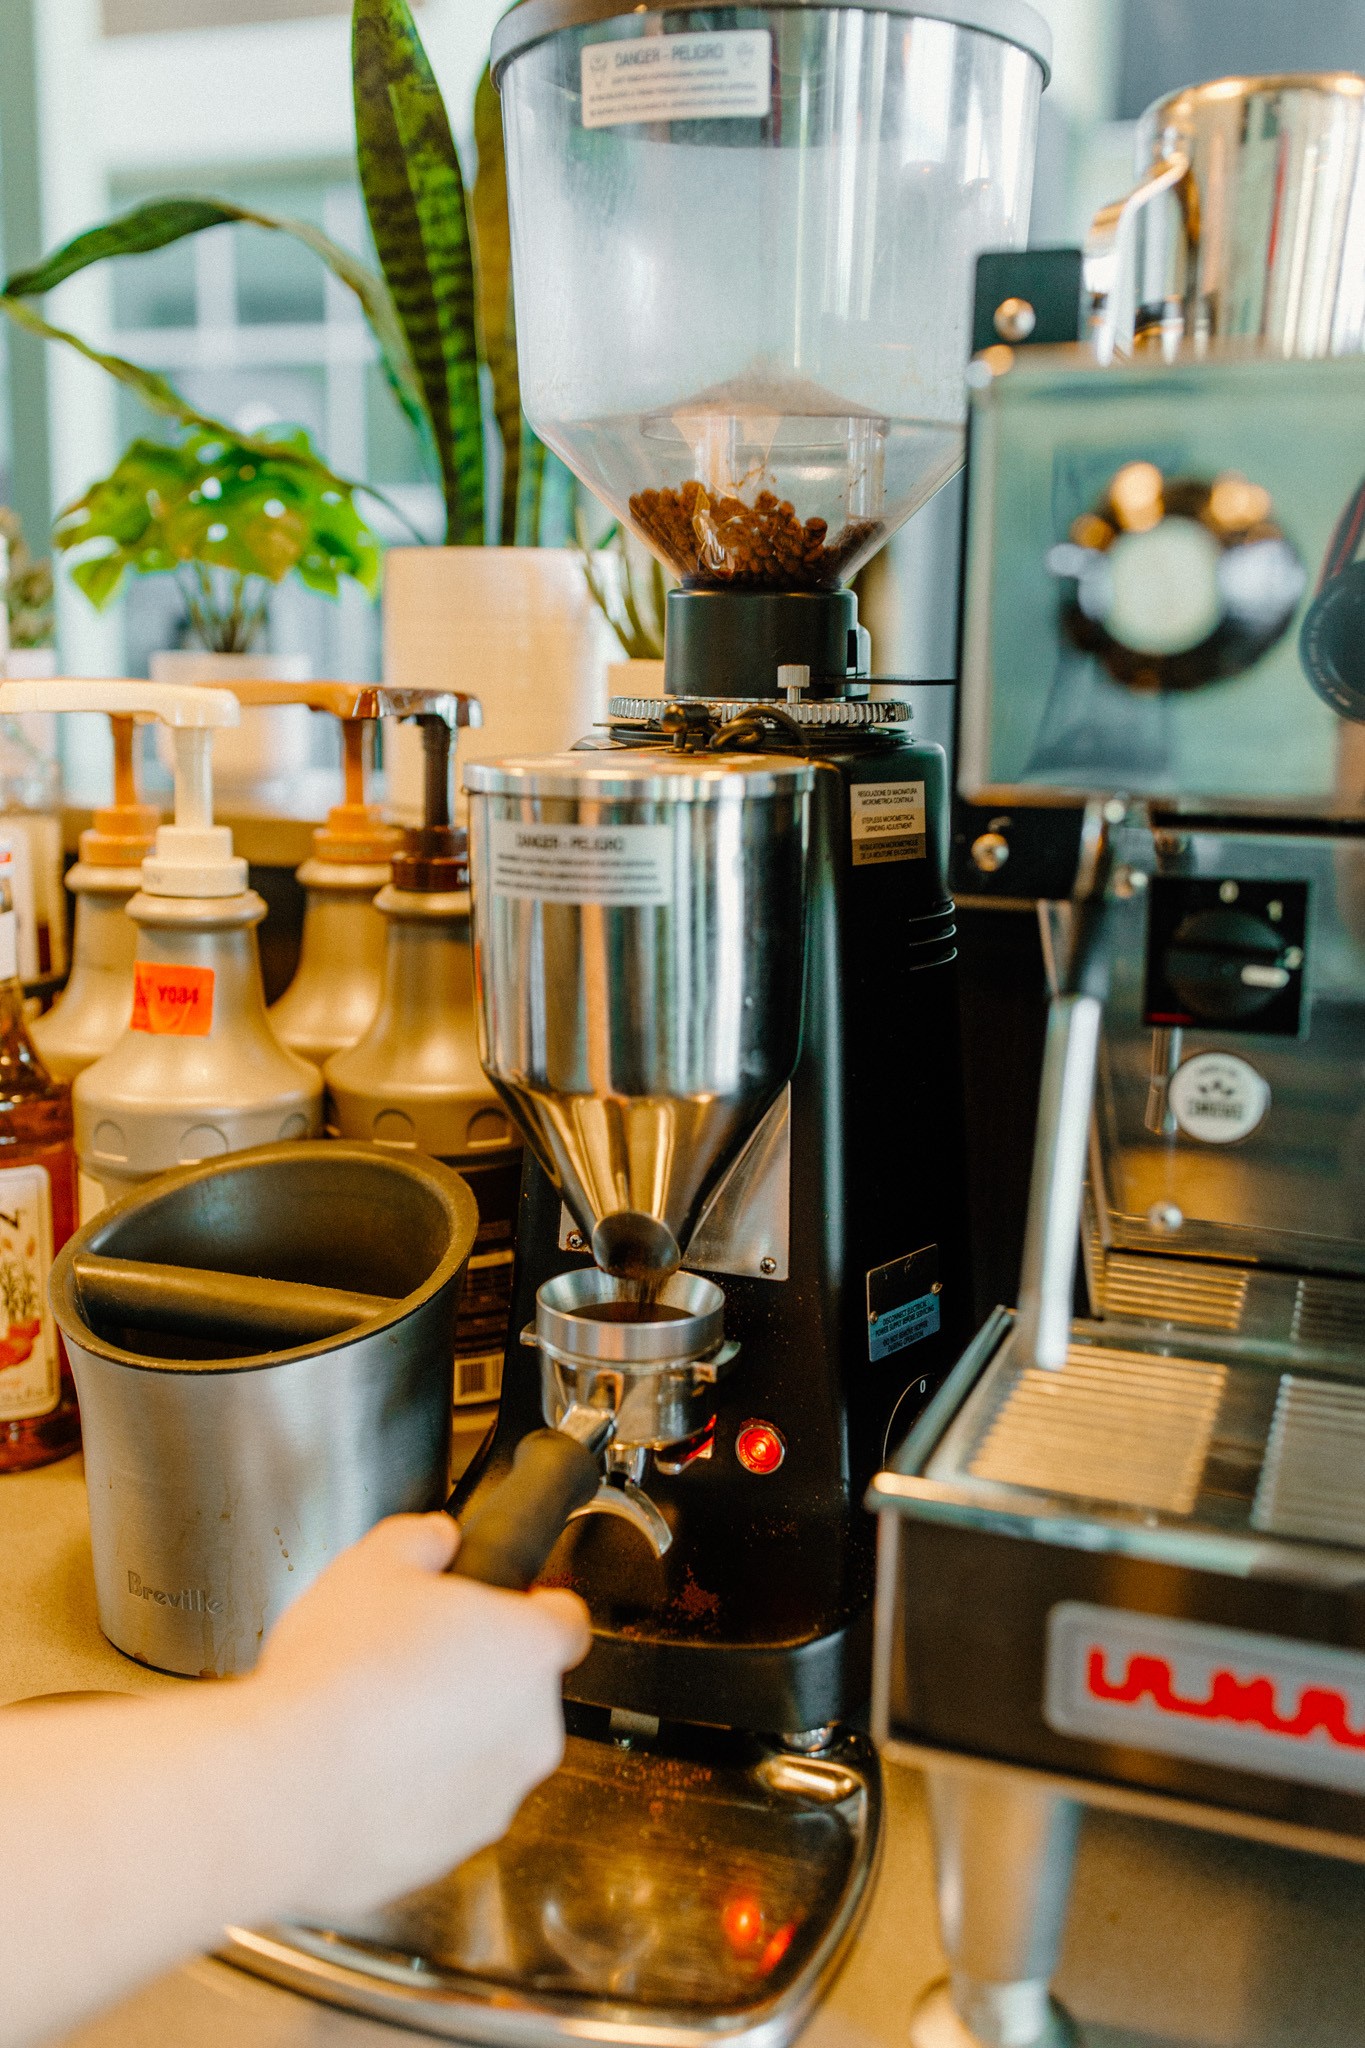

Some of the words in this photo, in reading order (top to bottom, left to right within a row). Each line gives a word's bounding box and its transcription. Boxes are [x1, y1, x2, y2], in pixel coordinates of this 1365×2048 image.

[615, 48, 660, 67] DANGER
[671, 43, 723, 61] PELIGRO
[516, 834, 558, 849] DANGER
[571, 836, 625, 851] PELIGRO
[883, 1310, 906, 1325] DISCONNECT
[127, 1569, 224, 1615] Breville
